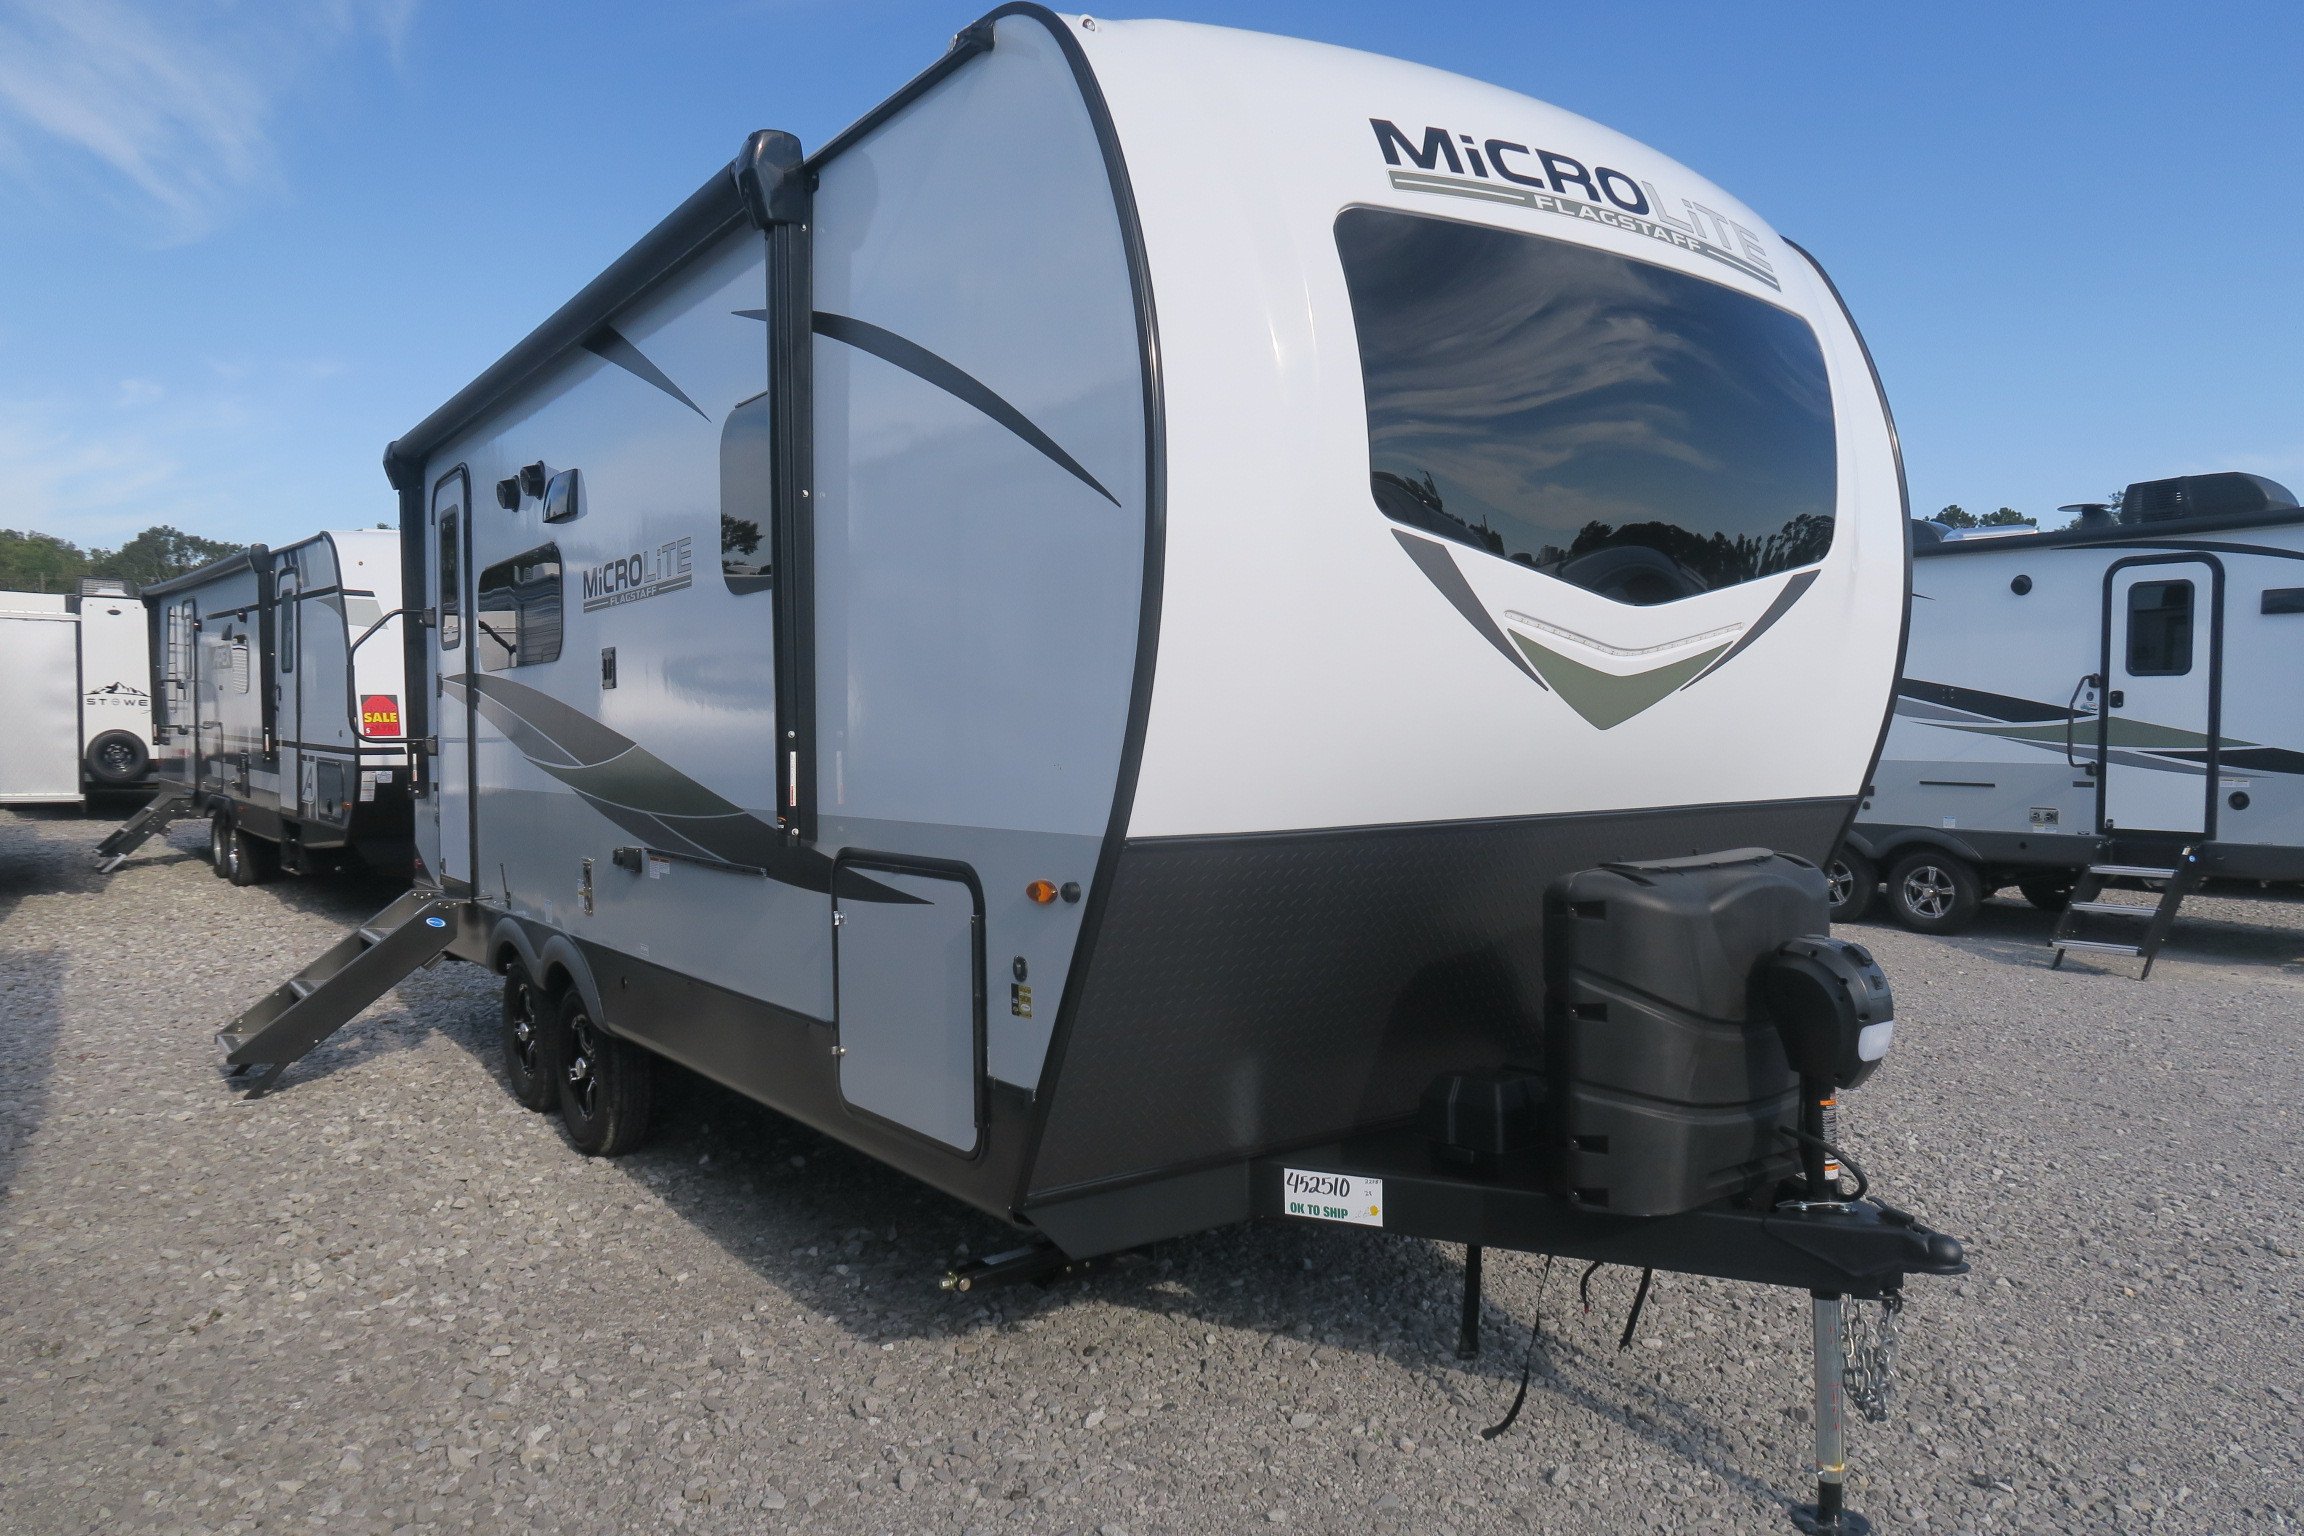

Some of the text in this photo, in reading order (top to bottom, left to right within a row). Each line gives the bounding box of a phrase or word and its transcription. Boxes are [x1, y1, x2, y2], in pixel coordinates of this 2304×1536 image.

[1533, 194, 1702, 251] FLAGSTAFF
[610, 586, 657, 606] FLAGSTAFF
[86, 698, 148, 706] STOWE
[363, 712, 398, 723] SALE
[1286, 1172, 1350, 1198] 452510
[1290, 1202, 1305, 1213] OK
[1307, 1205, 1320, 1216] TO
[1323, 1206, 1349, 1219] SHIP
